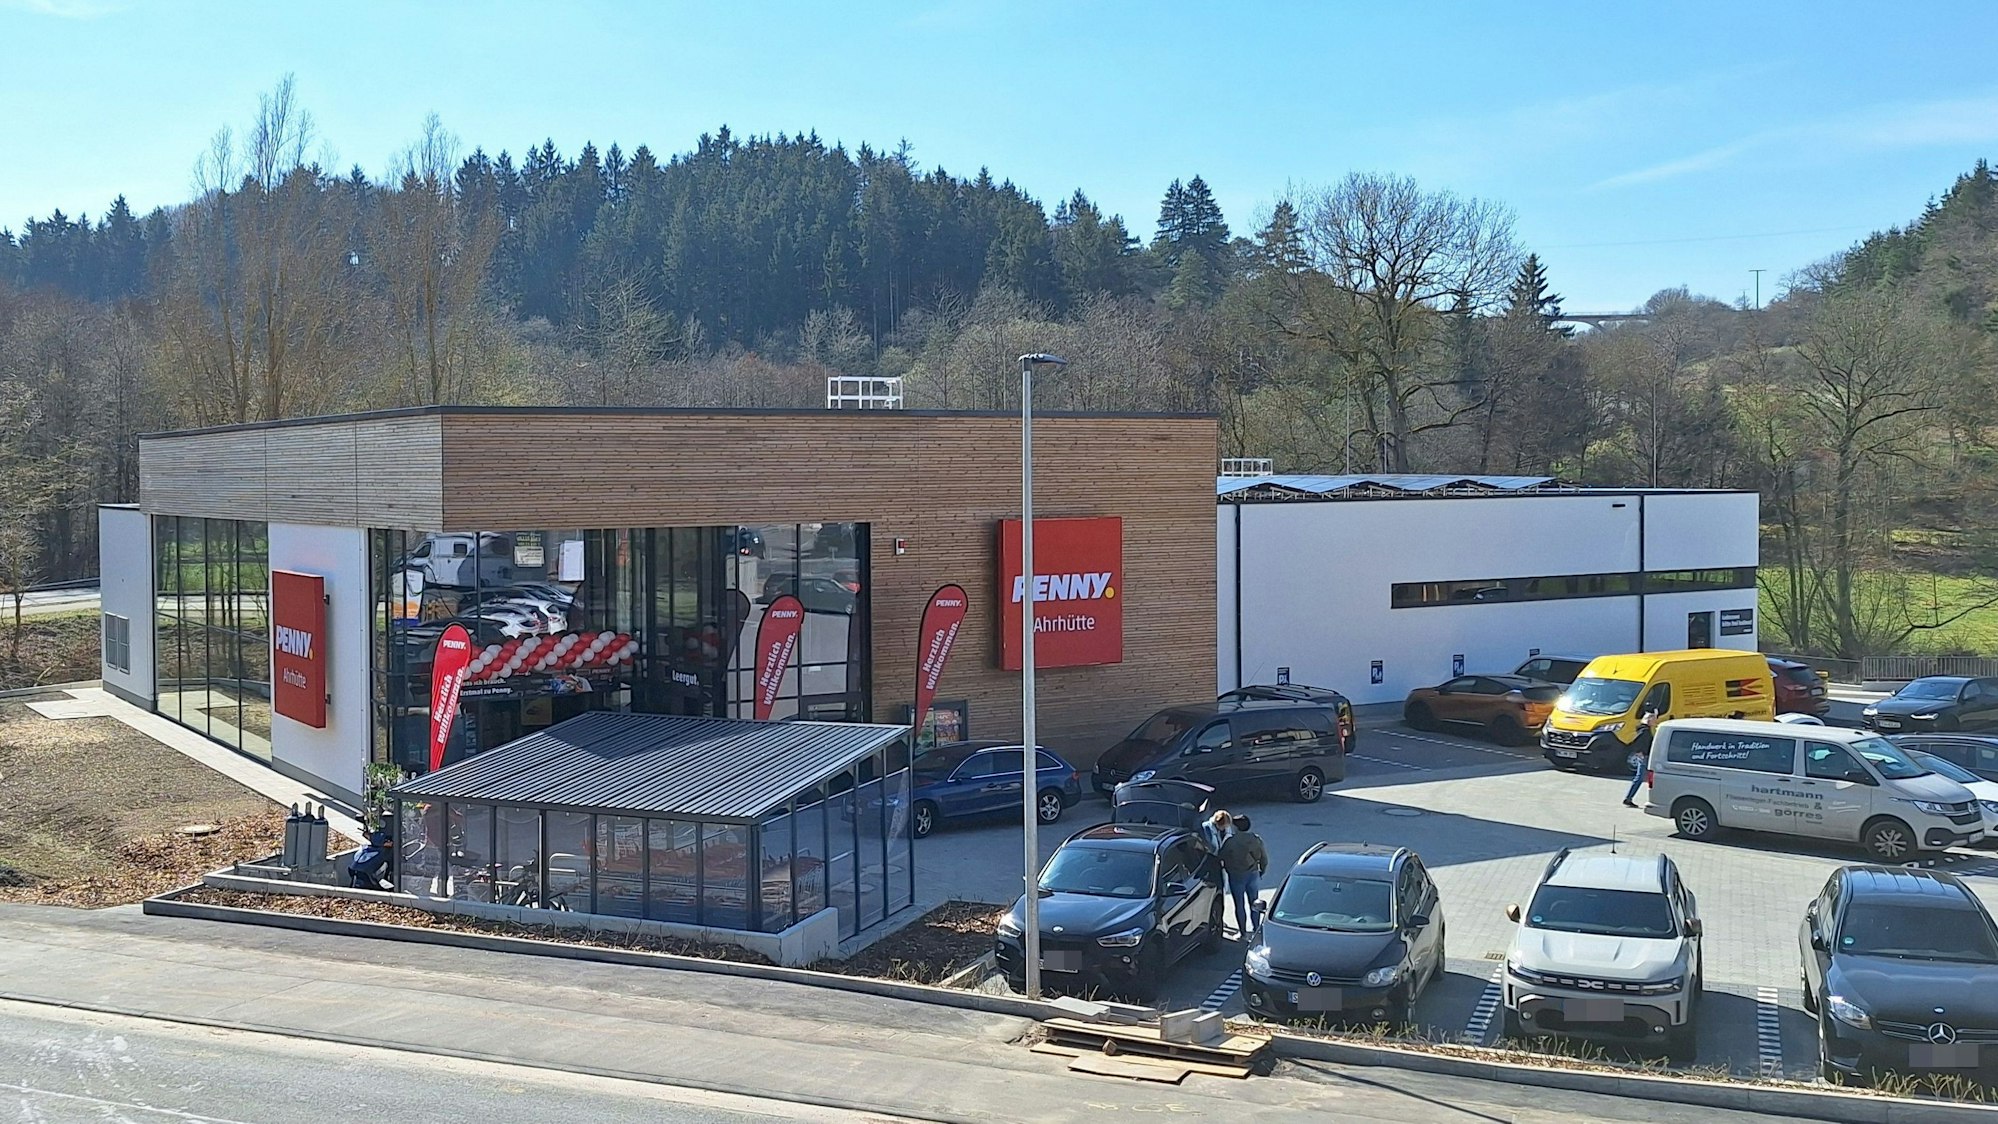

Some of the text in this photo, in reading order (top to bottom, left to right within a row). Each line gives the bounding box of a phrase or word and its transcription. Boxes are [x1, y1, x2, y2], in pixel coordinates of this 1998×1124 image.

[771, 610, 798, 618] PENNY.
[1033, 614, 1096, 633] Ahrhütte
[443, 640, 467, 650] PENNY.
[923, 629, 945, 673] Herzlich
[760, 641, 781, 687] Herzlich
[283, 667, 307, 689] Ahrhütte
[433, 674, 453, 723] Herzlich
[1691, 741, 1727, 751] Handwerk
[1738, 741, 1770, 750] Tradition
[1751, 784, 1824, 800] hartmann
